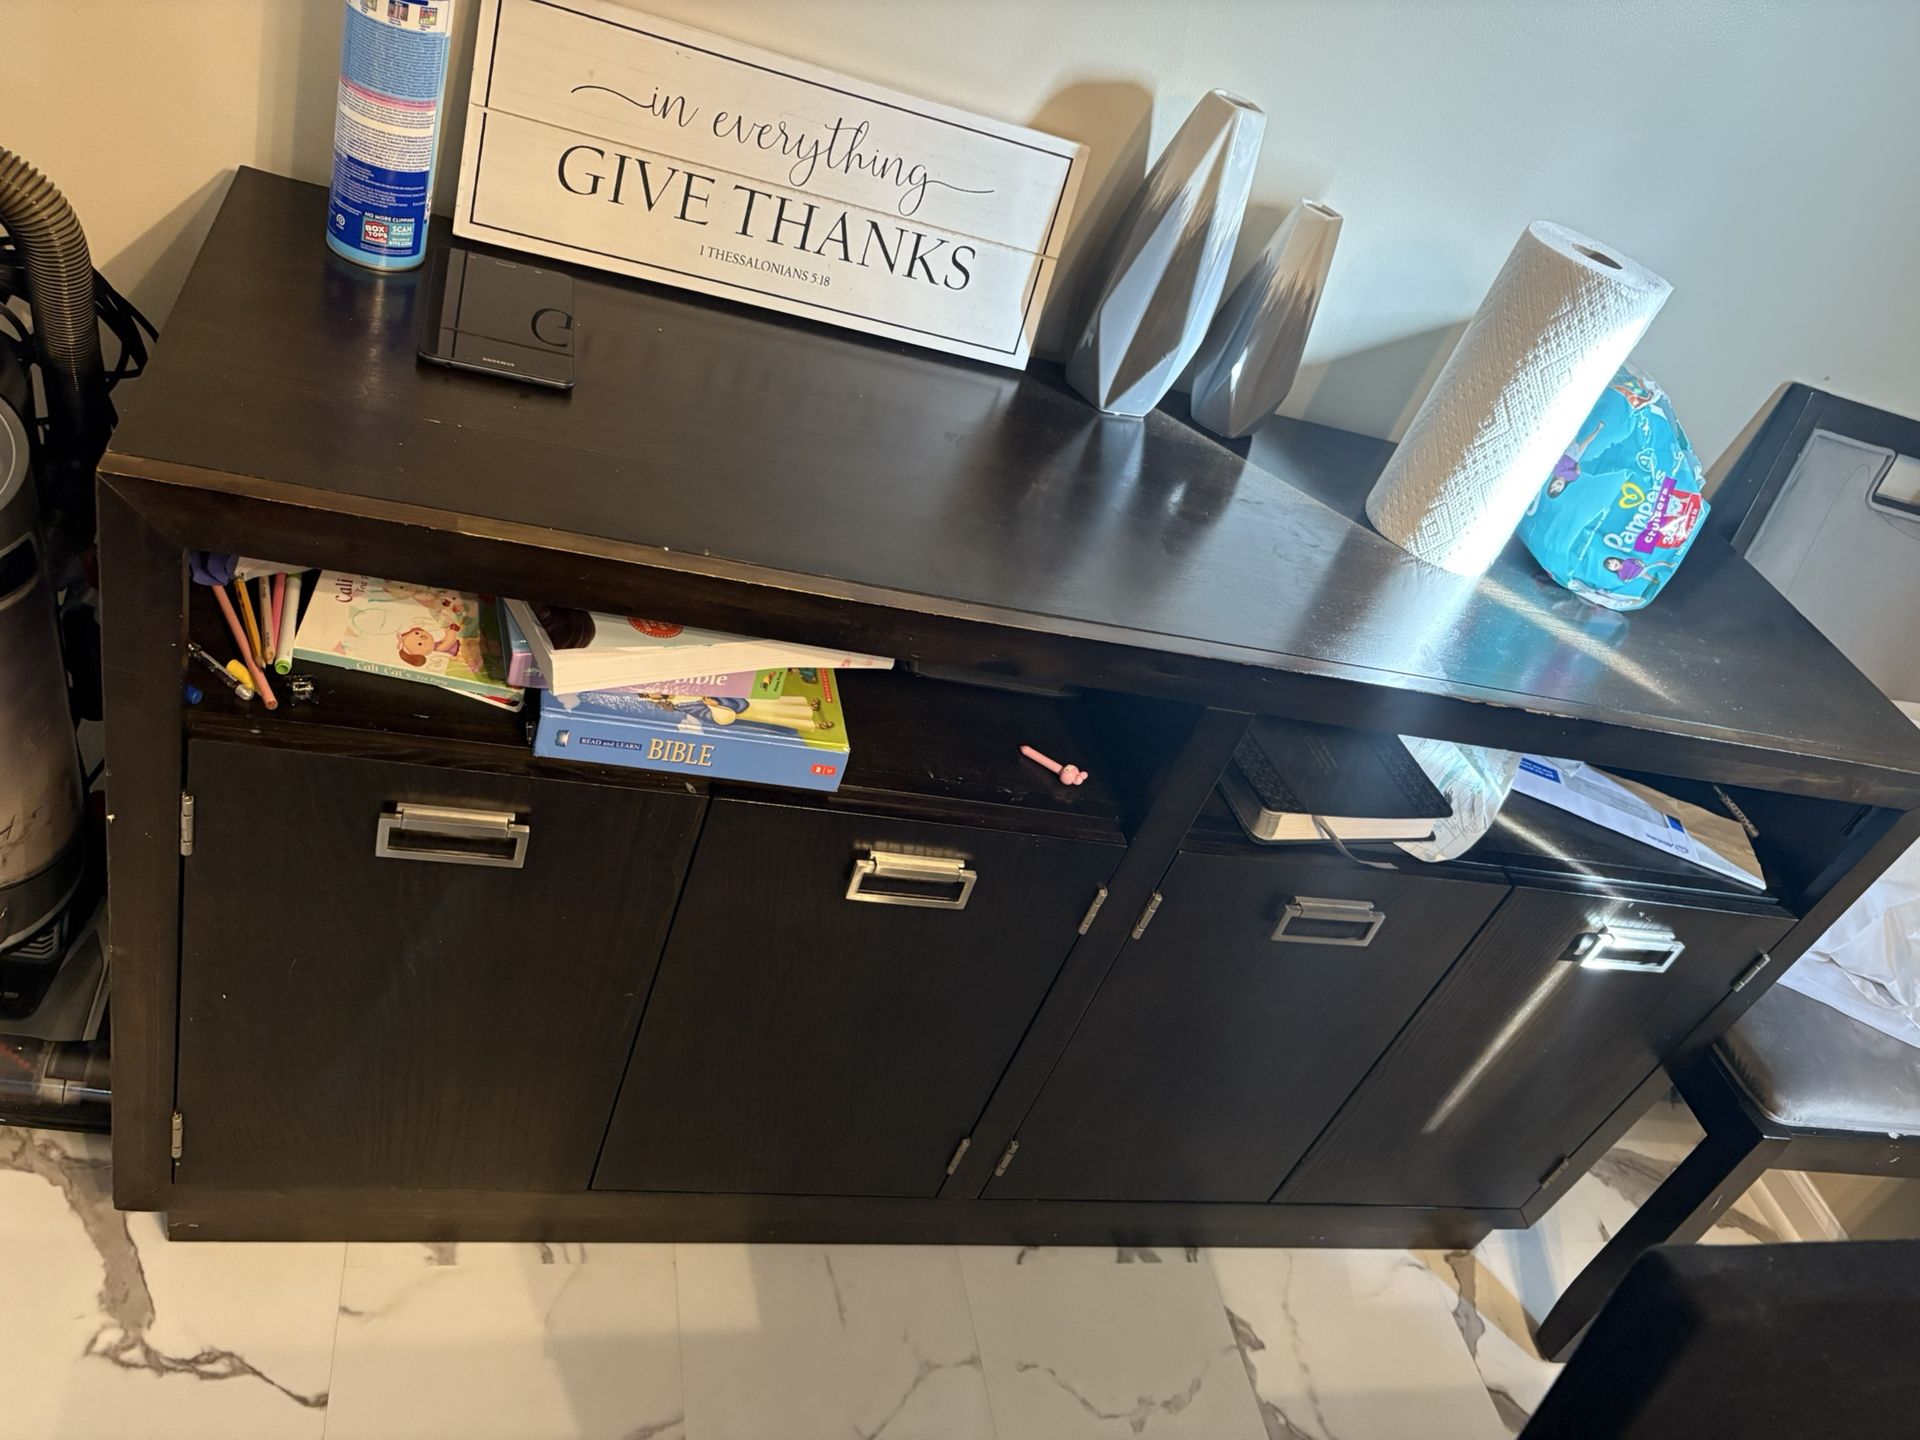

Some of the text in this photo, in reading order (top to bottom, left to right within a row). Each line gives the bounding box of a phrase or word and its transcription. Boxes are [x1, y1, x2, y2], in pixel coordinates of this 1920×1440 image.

[712, 111, 995, 216] everything
[365, 224, 412, 233] BOX SCAN
[557, 145, 977, 292] GIVE THANKS
[368, 231, 388, 239] TOPS
[707, 246, 809, 281] THESSALONIANS
[810, 272, 831, 287] 5:18
[1604, 470, 1667, 553] Pampers
[335, 578, 353, 603] Cali
[355, 661, 380, 675] Cali
[580, 737, 602, 747] READ
[615, 741, 641, 751] LEARN
[647, 738, 715, 767] BIBLE
